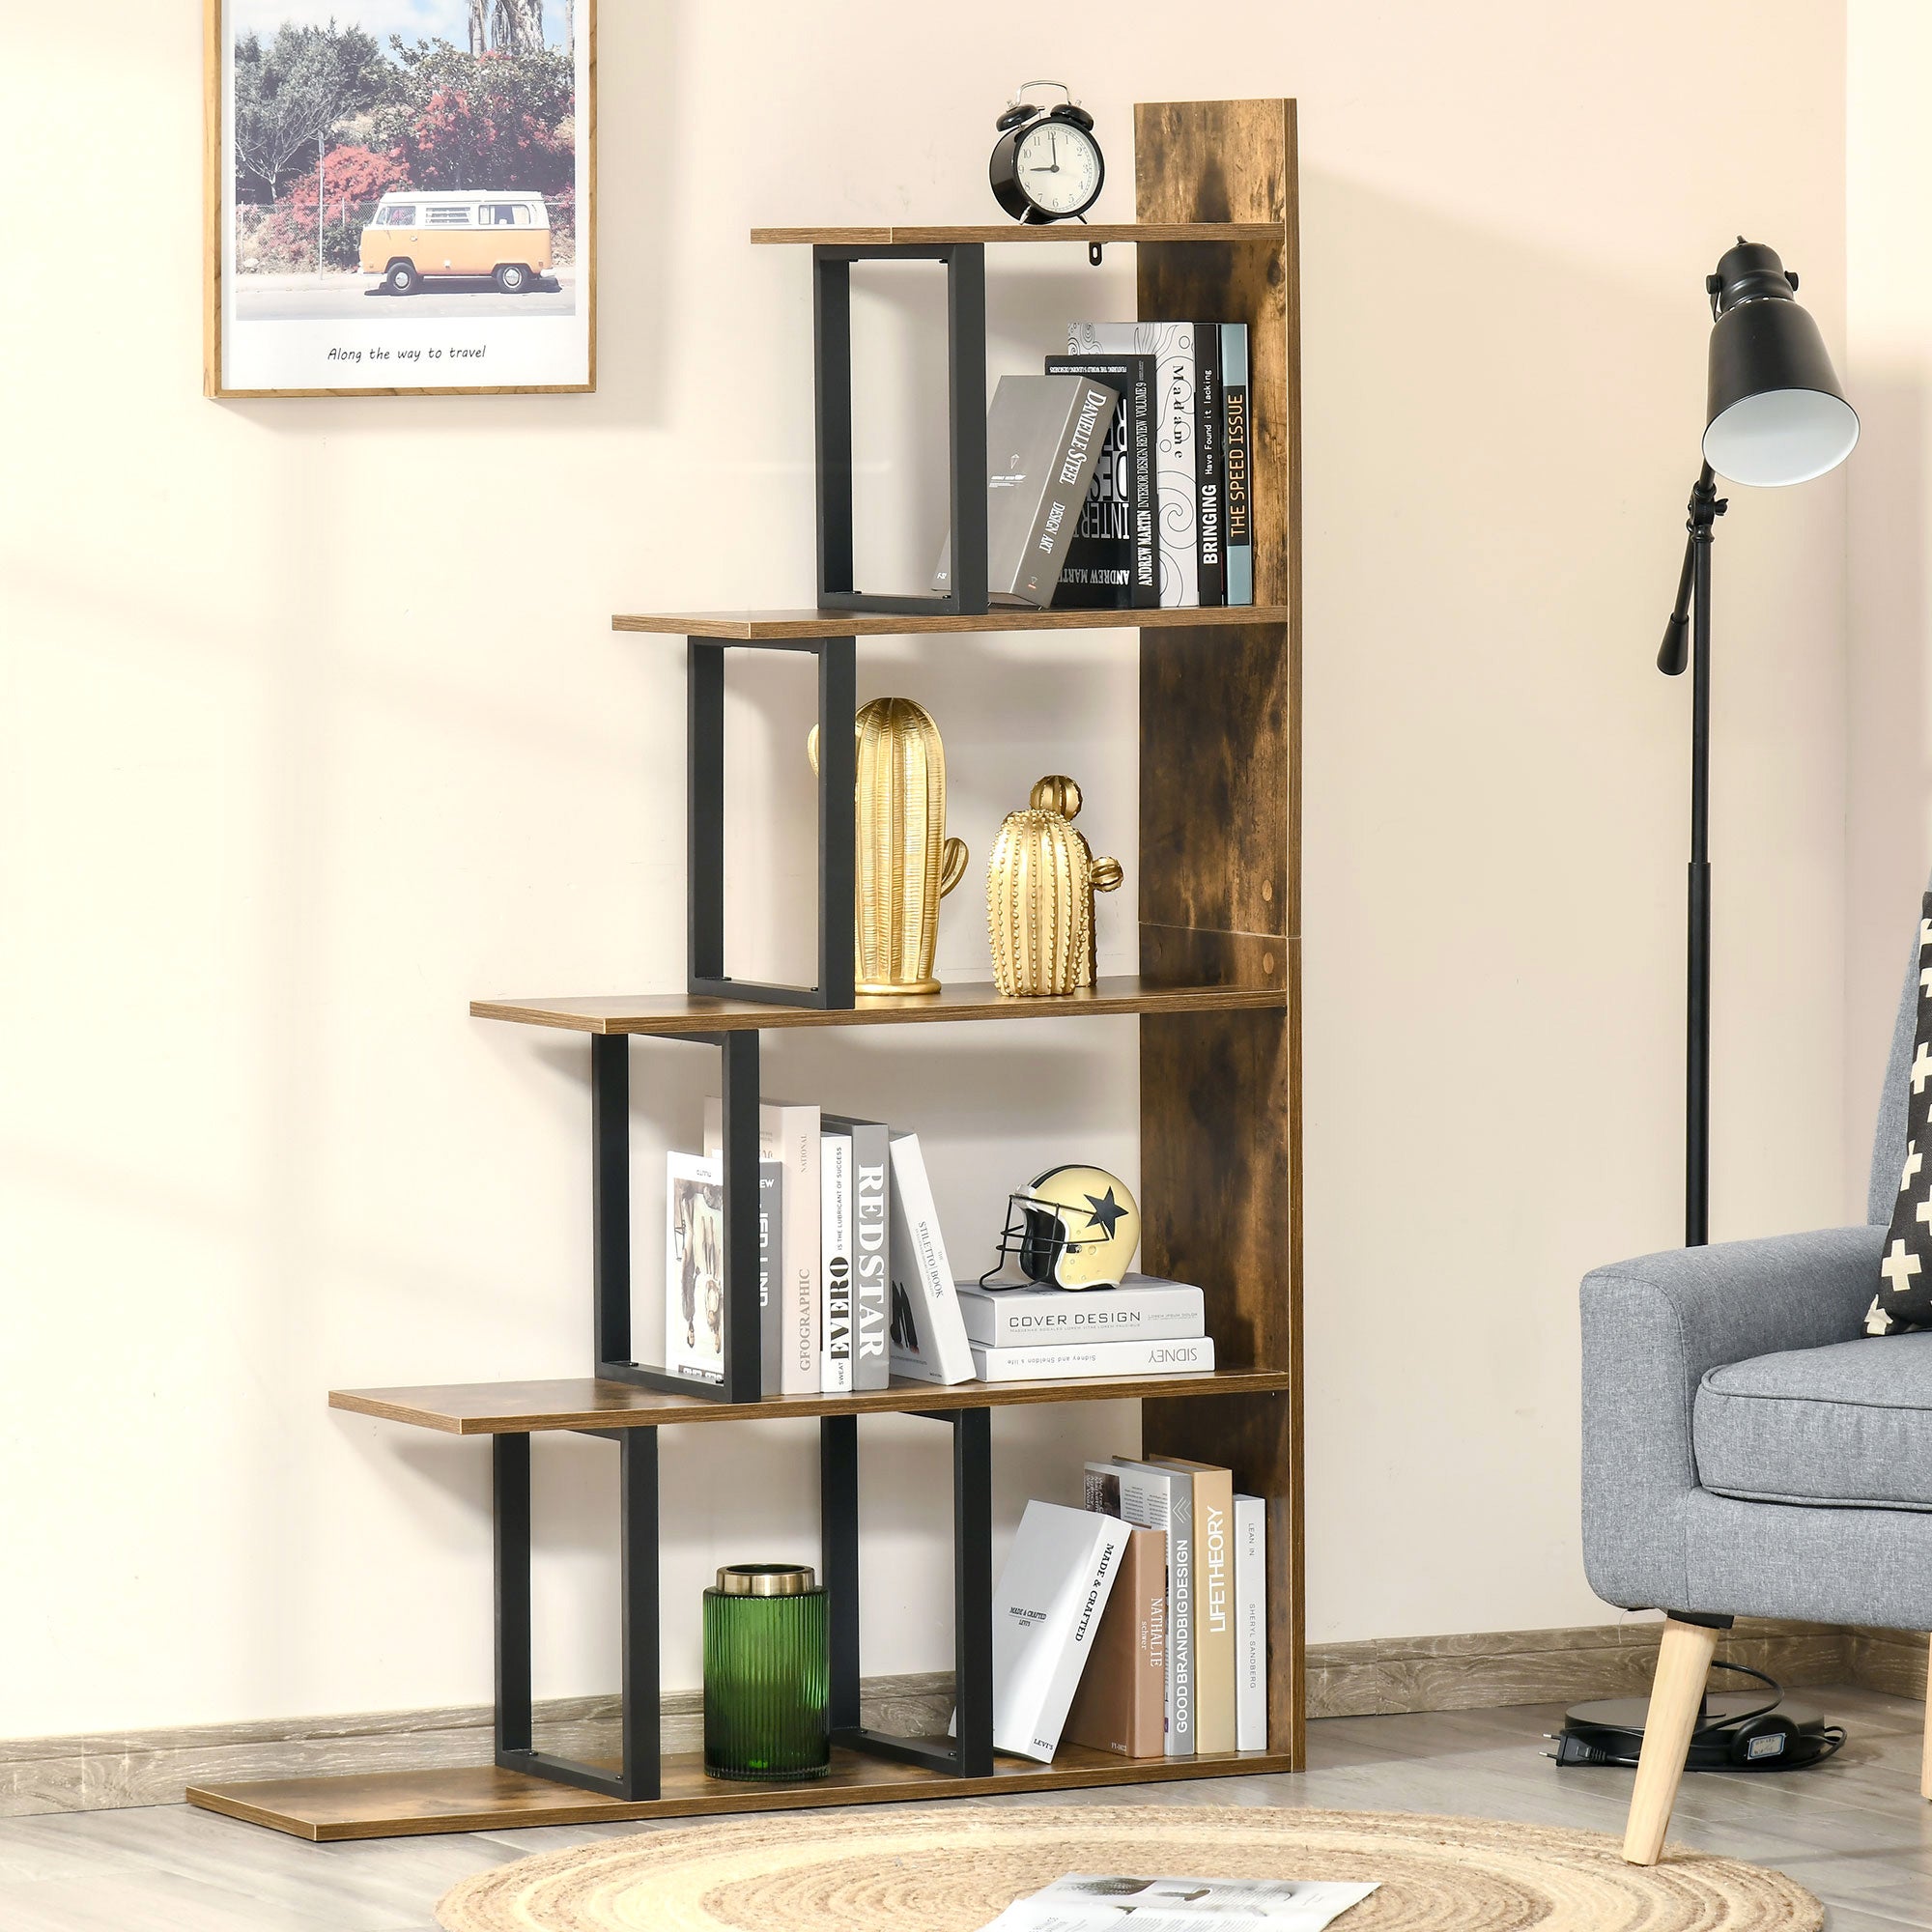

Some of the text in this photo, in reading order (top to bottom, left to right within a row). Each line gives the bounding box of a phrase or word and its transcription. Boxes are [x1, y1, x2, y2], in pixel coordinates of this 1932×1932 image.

[1034, 137, 1040, 146] 11
[1047, 131, 1057, 140] 12
[1023, 149, 1032, 158] 10
[1076, 147, 1083, 156] 2
[1018, 164, 1024, 174] 9
[1083, 164, 1090, 174] 3
[1025, 182, 1031, 190] 8
[1037, 193, 1043, 203] 7
[1068, 193, 1074, 203] 5
[1079, 181, 1084, 190] 4
[1053, 197, 1059, 207] 6
[327, 345, 486, 363] Along the way to travel
[1136, 388, 1147, 417] VOLUME
[1173, 365, 1184, 458] Madame
[1059, 388, 1107, 485] DANIELLE STEEL
[1136, 420, 1148, 446] REVIEW
[1136, 447, 1148, 474] DESIGN
[1202, 369, 1219, 564] BRINGING Have Found it lacking
[1228, 394, 1245, 537] THE SPEED ISSUE
[1137, 475, 1150, 508] INTERIOR
[1038, 500, 1066, 554] DESIGN ART
[1138, 510, 1151, 545] MARTIN
[1090, 568, 1130, 585] ANDREW
[1138, 547, 1152, 586] ANDREW
[858, 1163, 885, 1360] REDSTAR
[918, 1221, 945, 1299] STILETTO BOOK
[829, 1256, 850, 1360] EVERO
[1009, 1311, 1142, 1328] COVER DESIGN
[1148, 1348, 1198, 1364] SIDNEY
[1248, 1548, 1255, 1556] IN
[1177, 1540, 1188, 1600] DESIGN
[1207, 1505, 1226, 1633] LIFETHEORY
[1074, 1543, 1115, 1642] MADE & CRAFTED
[1151, 1598, 1163, 1667] NATHALIE
[1177, 1685, 1188, 1733] GOOD
